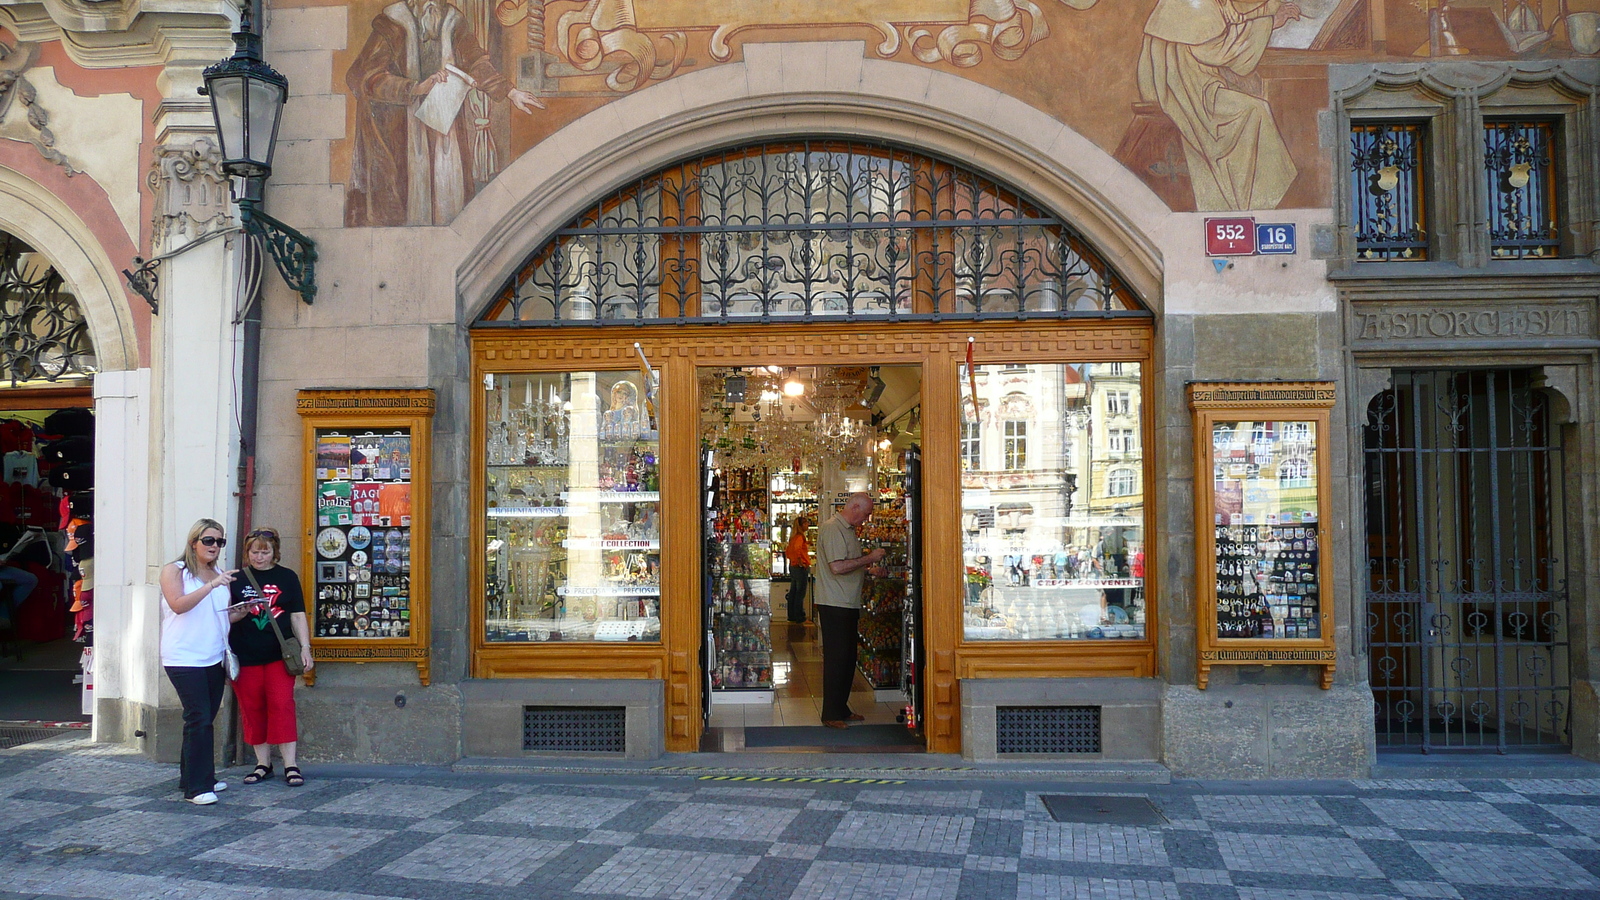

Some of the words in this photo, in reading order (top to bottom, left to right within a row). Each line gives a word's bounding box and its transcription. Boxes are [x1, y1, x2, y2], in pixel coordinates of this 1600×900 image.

[1216, 224, 1246, 240] 552
[1267, 227, 1287, 243] 16
[617, 491, 659, 499] CRYSTAL
[495, 507, 532, 515] BOHEMIA
[534, 507, 566, 515] CRYSTAL
